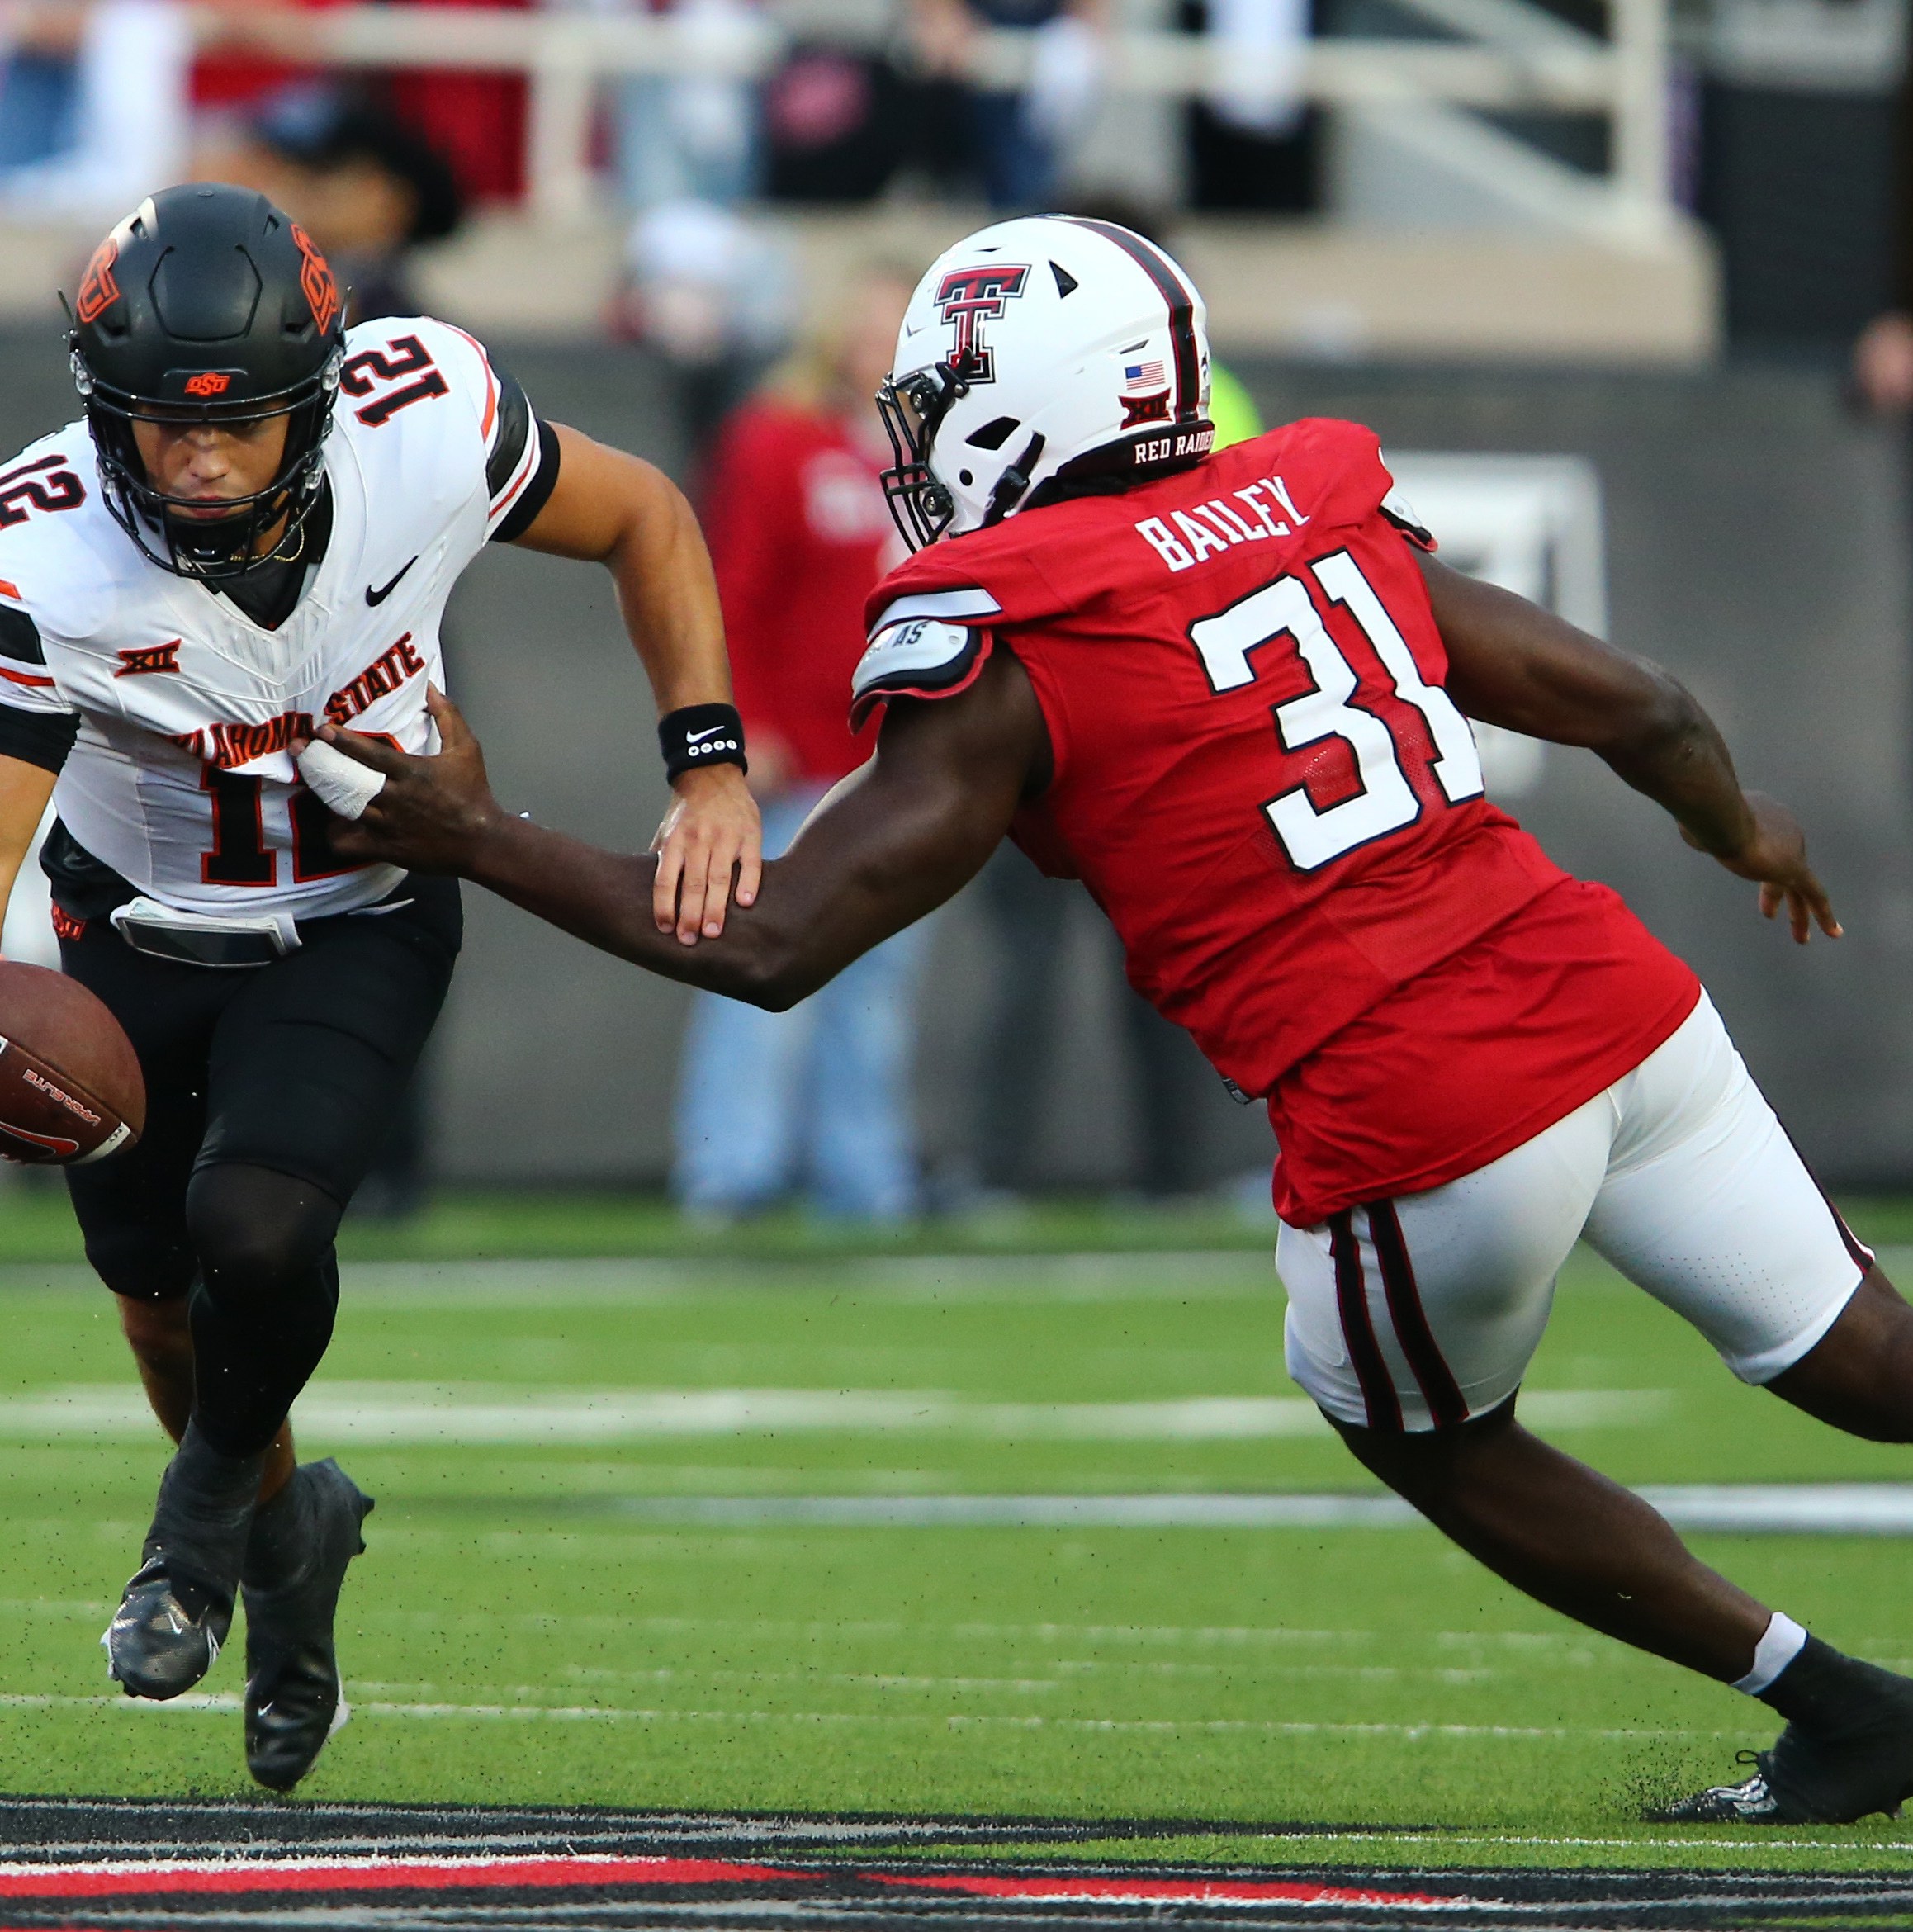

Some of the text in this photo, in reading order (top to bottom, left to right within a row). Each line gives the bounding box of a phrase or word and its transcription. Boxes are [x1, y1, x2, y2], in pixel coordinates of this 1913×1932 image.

[185, 372, 230, 396] OSU
[336, 333, 450, 428] 12
[1134, 429, 1215, 464] RED RAIDE
[1134, 475, 1310, 573] BAILEY
[324, 631, 426, 726] STATE
[1186, 546, 1485, 874] 31
